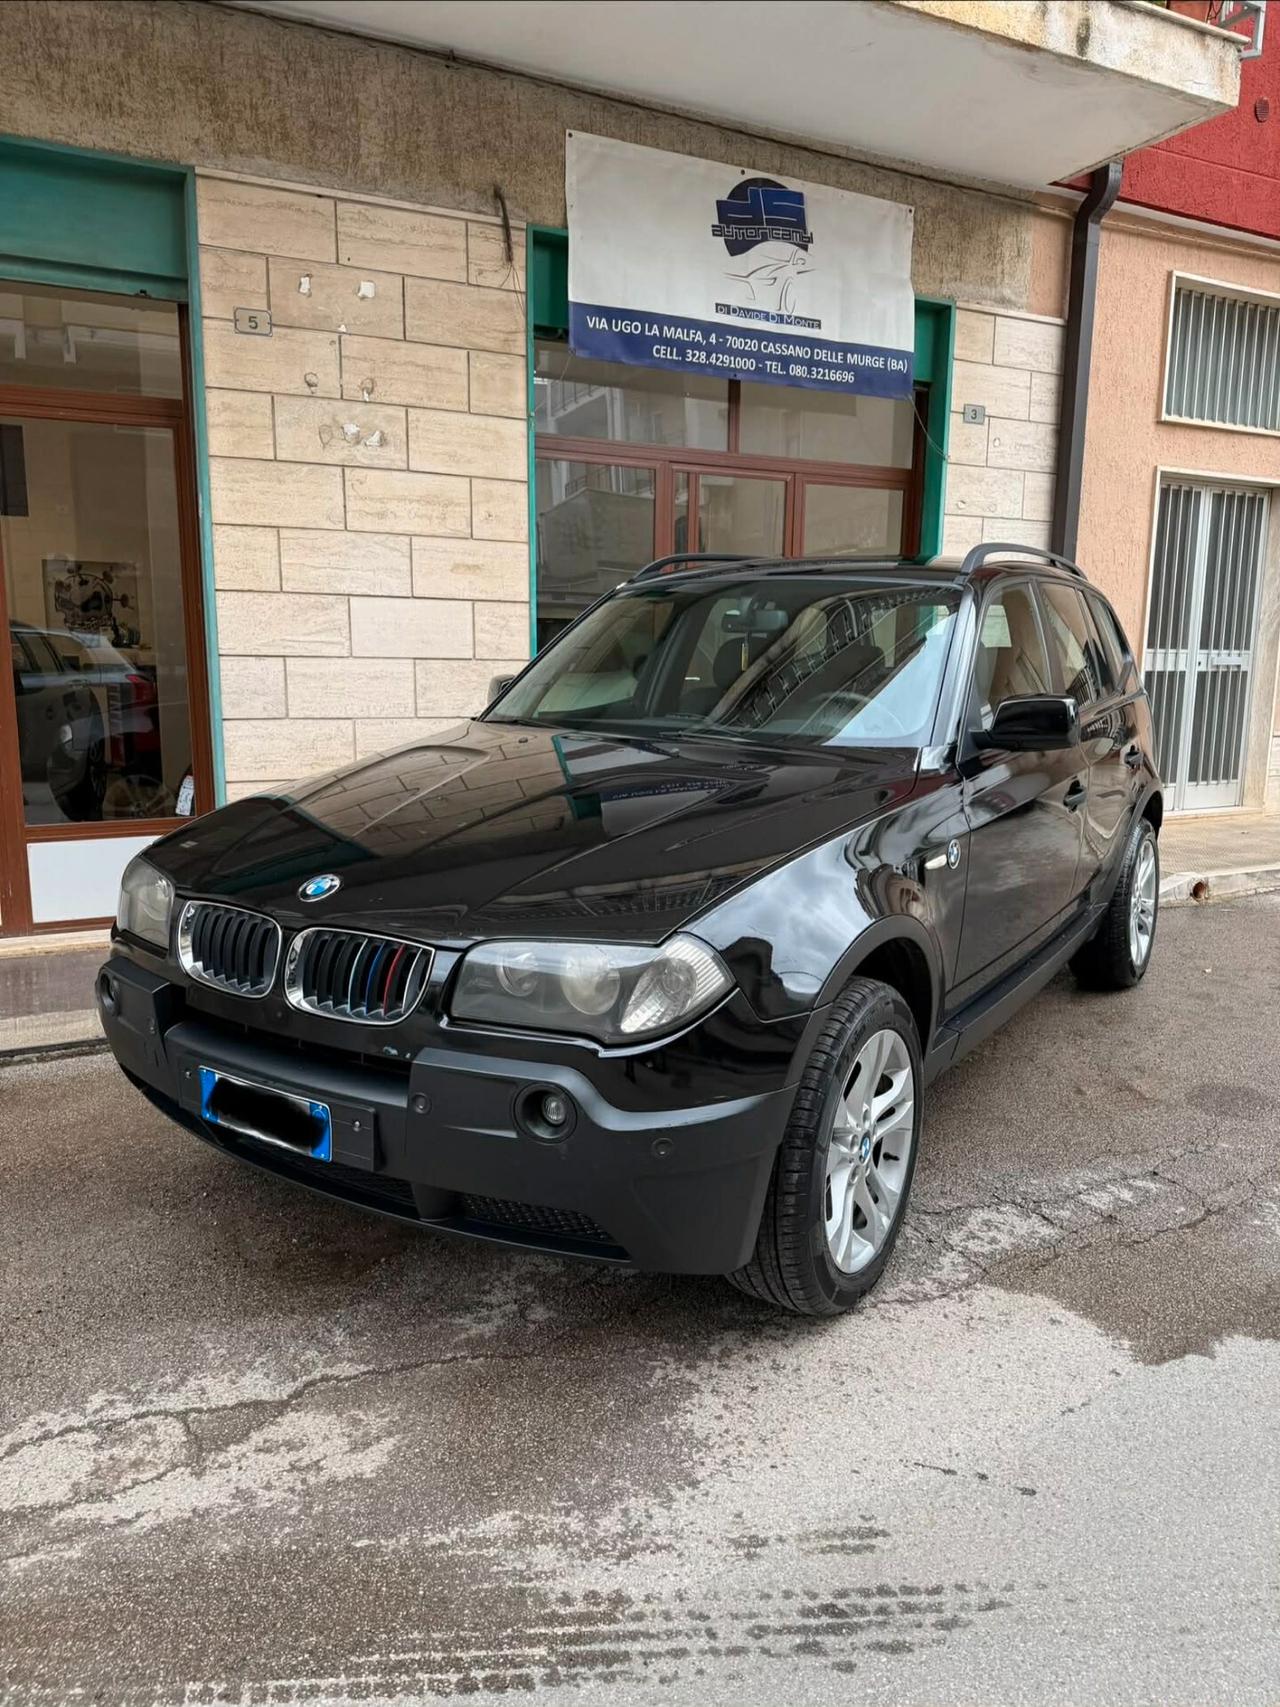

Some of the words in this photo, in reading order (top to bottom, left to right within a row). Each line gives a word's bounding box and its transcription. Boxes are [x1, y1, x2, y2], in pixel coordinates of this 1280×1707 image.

[248, 315, 258, 330] 5
[586, 315, 609, 331] VIA
[612, 319, 642, 334] UGO
[645, 322, 660, 337] LA
[663, 325, 706, 346] MALFA,
[709, 332, 717, 345] 4
[725, 335, 759, 352] 70020
[761, 340, 811, 359] CASSANO
[814, 348, 844, 364] DELLE
[847, 353, 885, 369] MURGE
[887, 357, 908, 374] (BA)
[652, 344, 682, 361] CELL.
[685, 349, 756, 371] 328.4291000
[765, 360, 787, 375] TEL.
[789, 363, 855, 384] 080.3216696
[970, 408, 978, 421] 3
